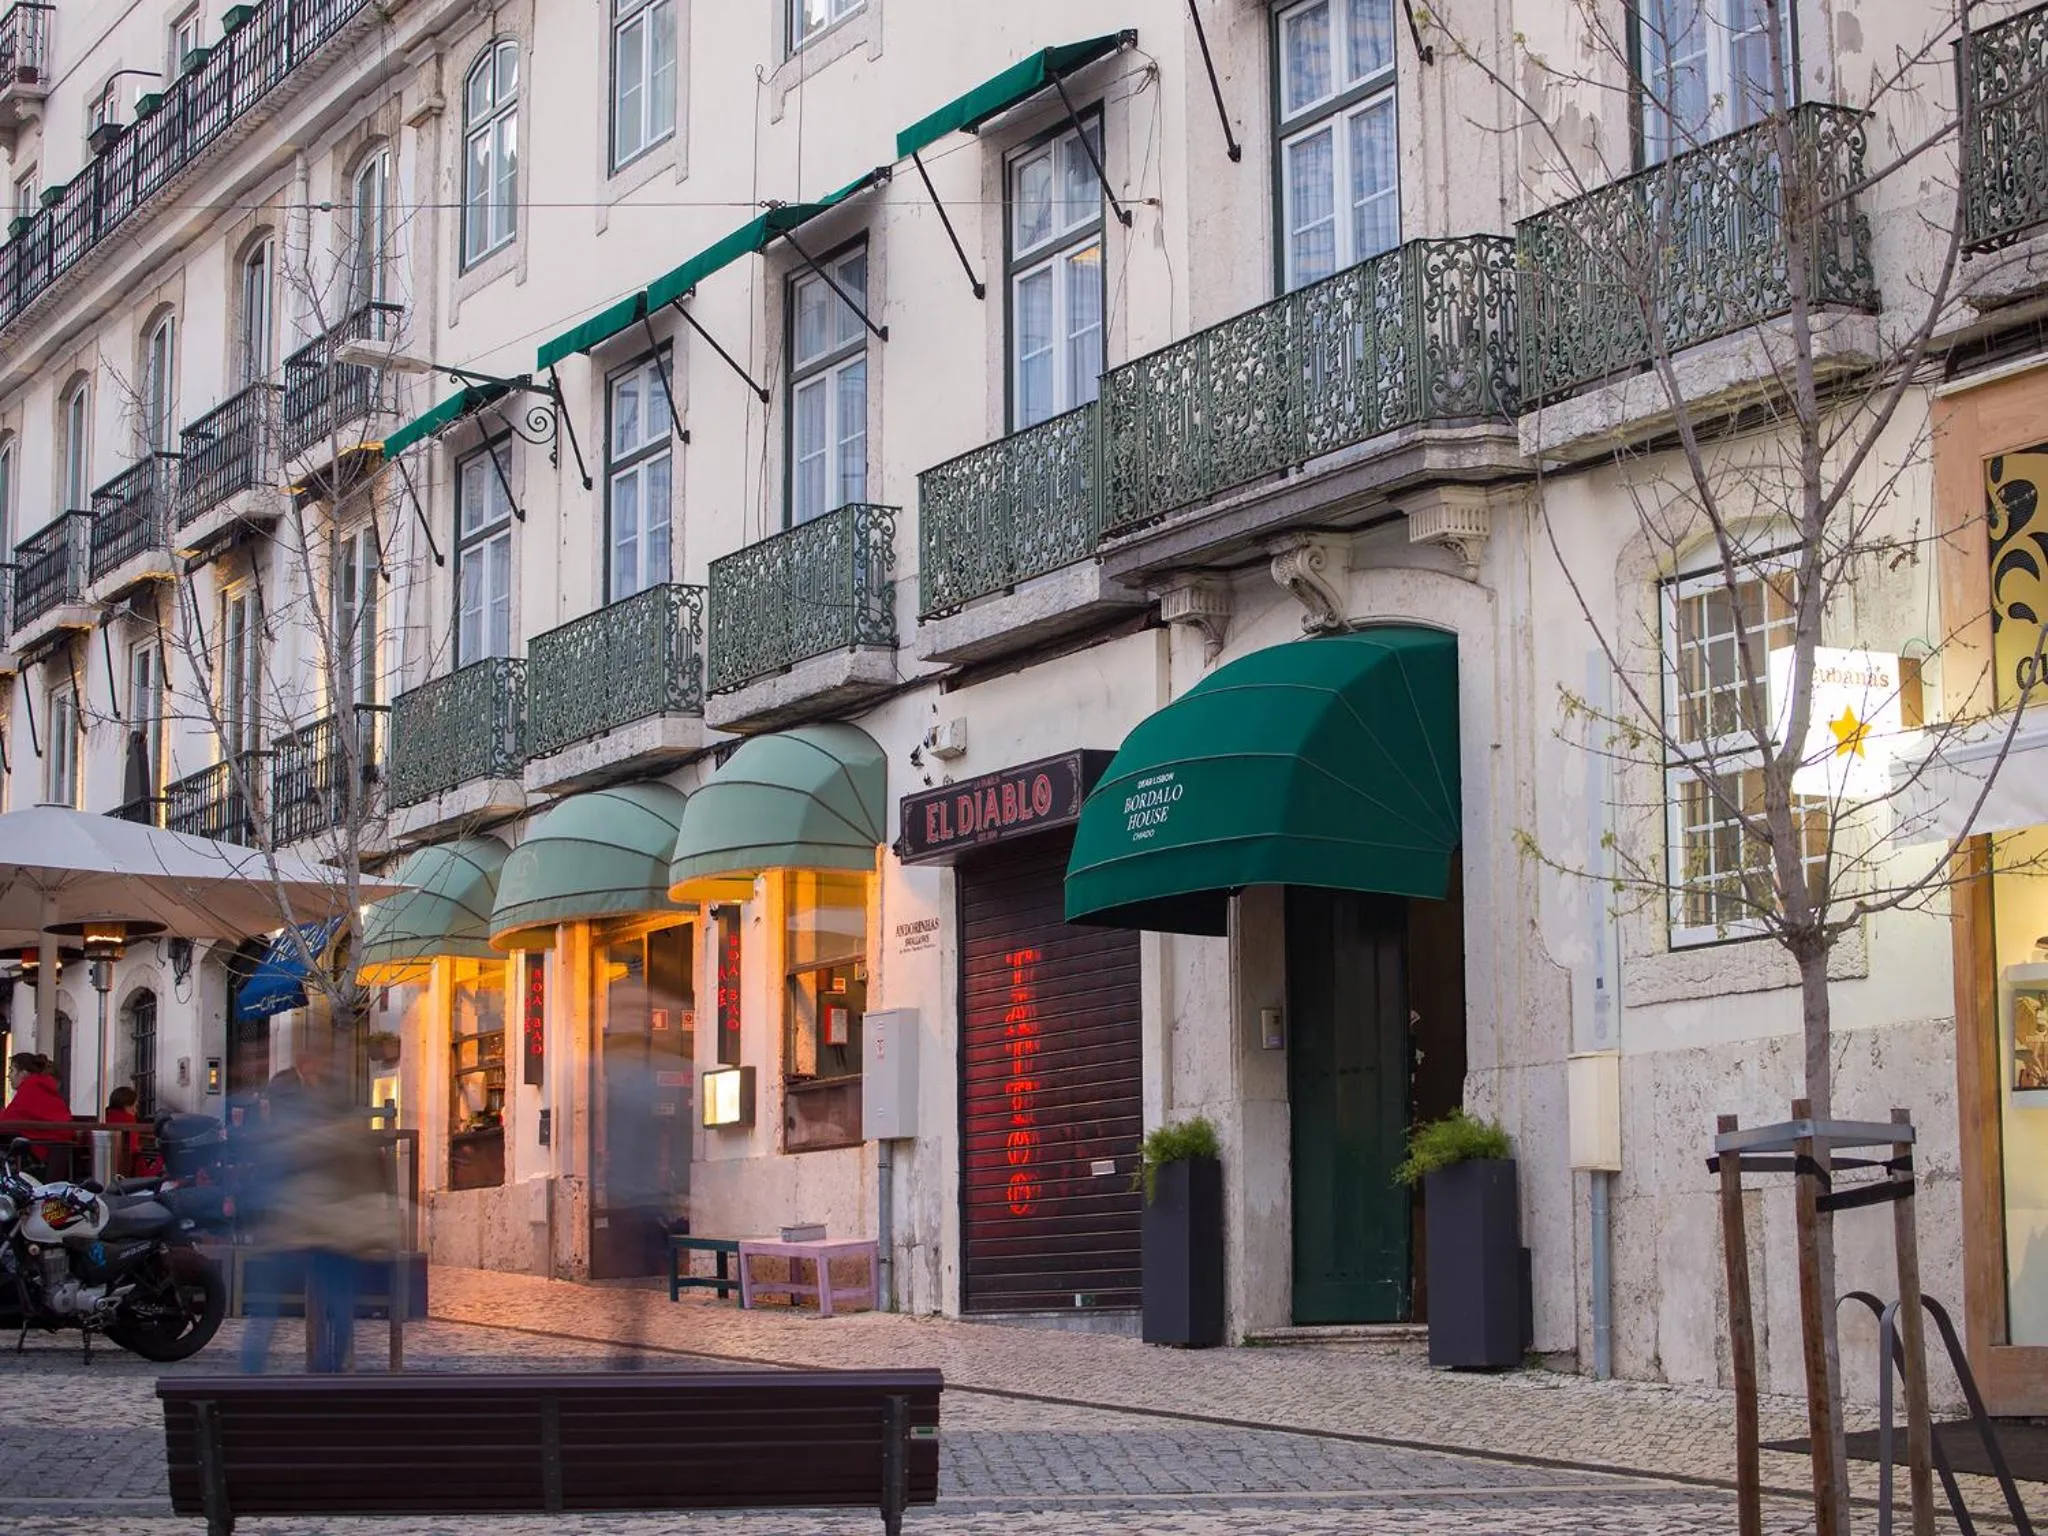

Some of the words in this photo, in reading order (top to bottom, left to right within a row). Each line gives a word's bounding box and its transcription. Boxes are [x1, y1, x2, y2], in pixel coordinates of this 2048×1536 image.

[926, 800, 954, 844] EL
[957, 773, 1053, 836] DIABLO
[1123, 783, 1183, 815] BORDALO
[1127, 805, 1169, 831] HOUSE
[1004, 949, 1038, 1214] TATTOO
